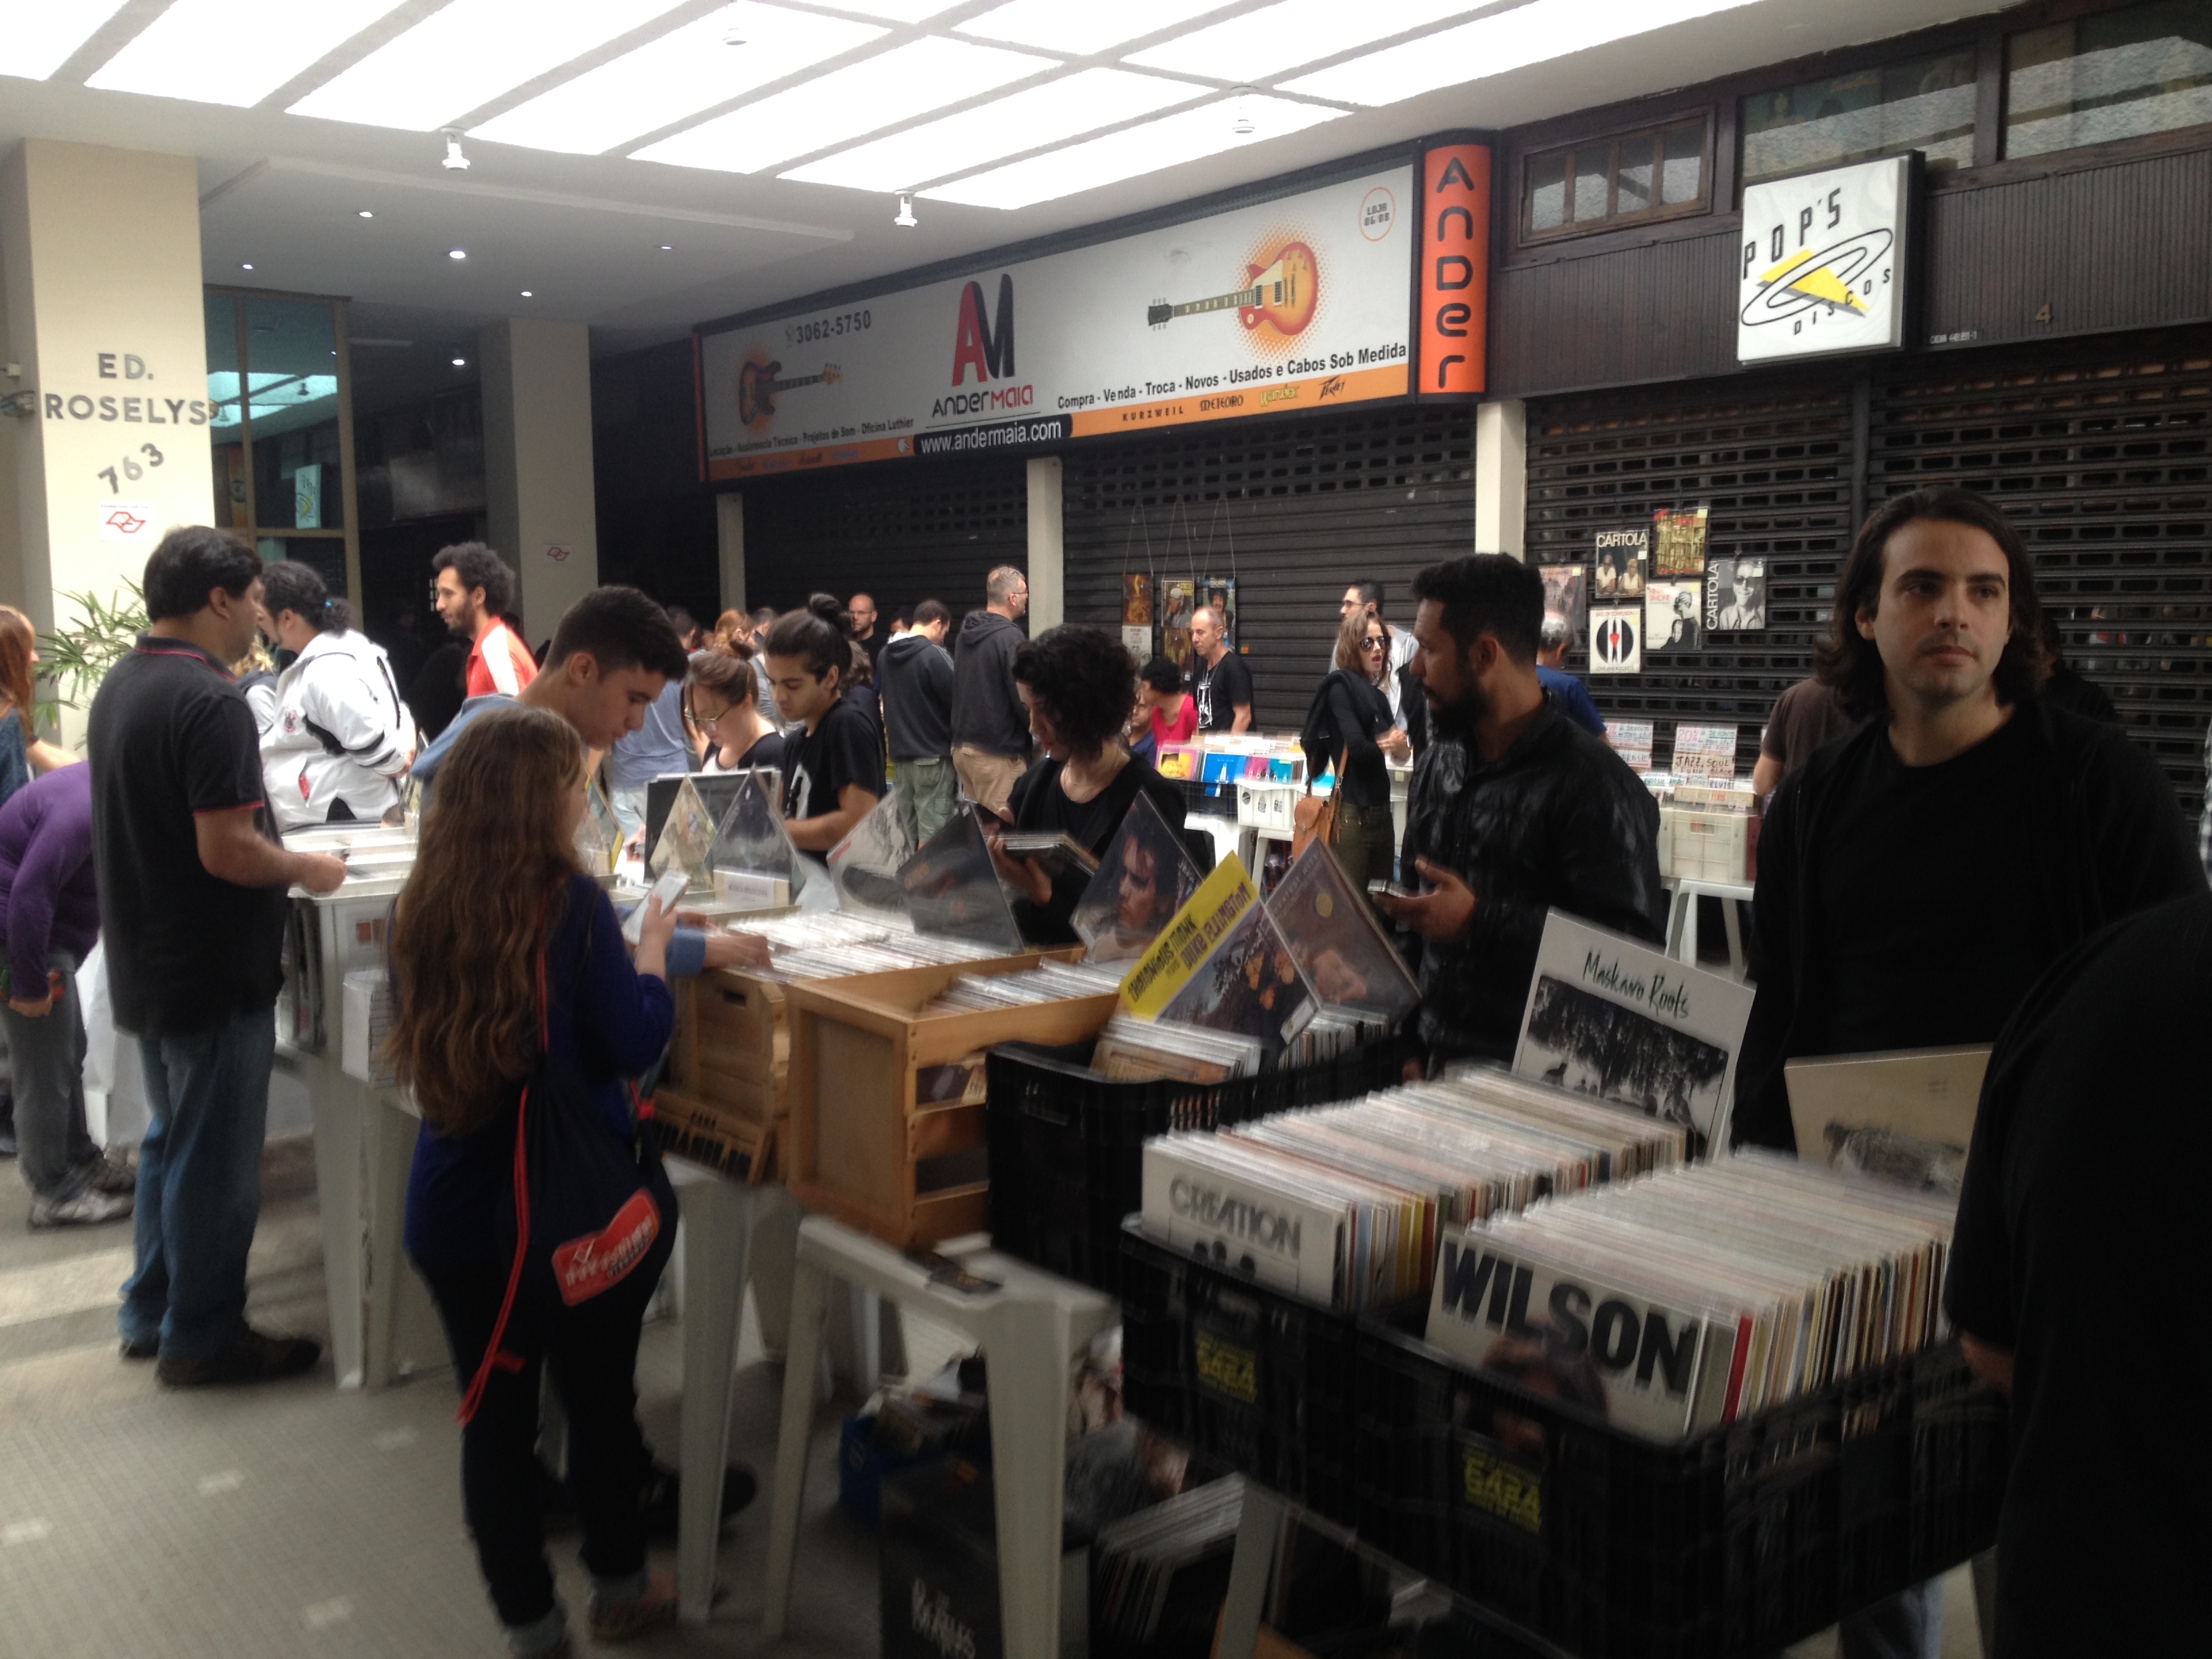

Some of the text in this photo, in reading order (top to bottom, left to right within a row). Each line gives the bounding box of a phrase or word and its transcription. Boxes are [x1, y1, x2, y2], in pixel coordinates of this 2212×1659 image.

[1794, 268, 1891, 335] DISCOS
[2035, 304, 2053, 324] 4
[796, 309, 872, 344] 3062-5750
[98, 353, 155, 380] ED.
[1058, 342, 1407, 409] Compra Venda Troca Novos Usados e Cabos Sob Medida
[45, 393, 209, 426] ROSELYS
[1122, 405, 1185, 422] KURZWEIL
[1200, 394, 1244, 411] METEORO
[861, 421, 887, 434] Oficina
[888, 417, 914, 431] Luthier
[920, 420, 1063, 454] www.andermaia.com
[98, 442, 165, 495] 763
[1597, 532, 1647, 549] CARTOLA
[1706, 562, 1720, 631] CARTOLA
[1677, 729, 1700, 743] 20%
[1706, 758, 1730, 767] SOUL
[1647, 973, 1690, 1019] Roots
[1168, 1173, 1301, 1259] CREATION
[1441, 1239, 1698, 1404] WILSON
